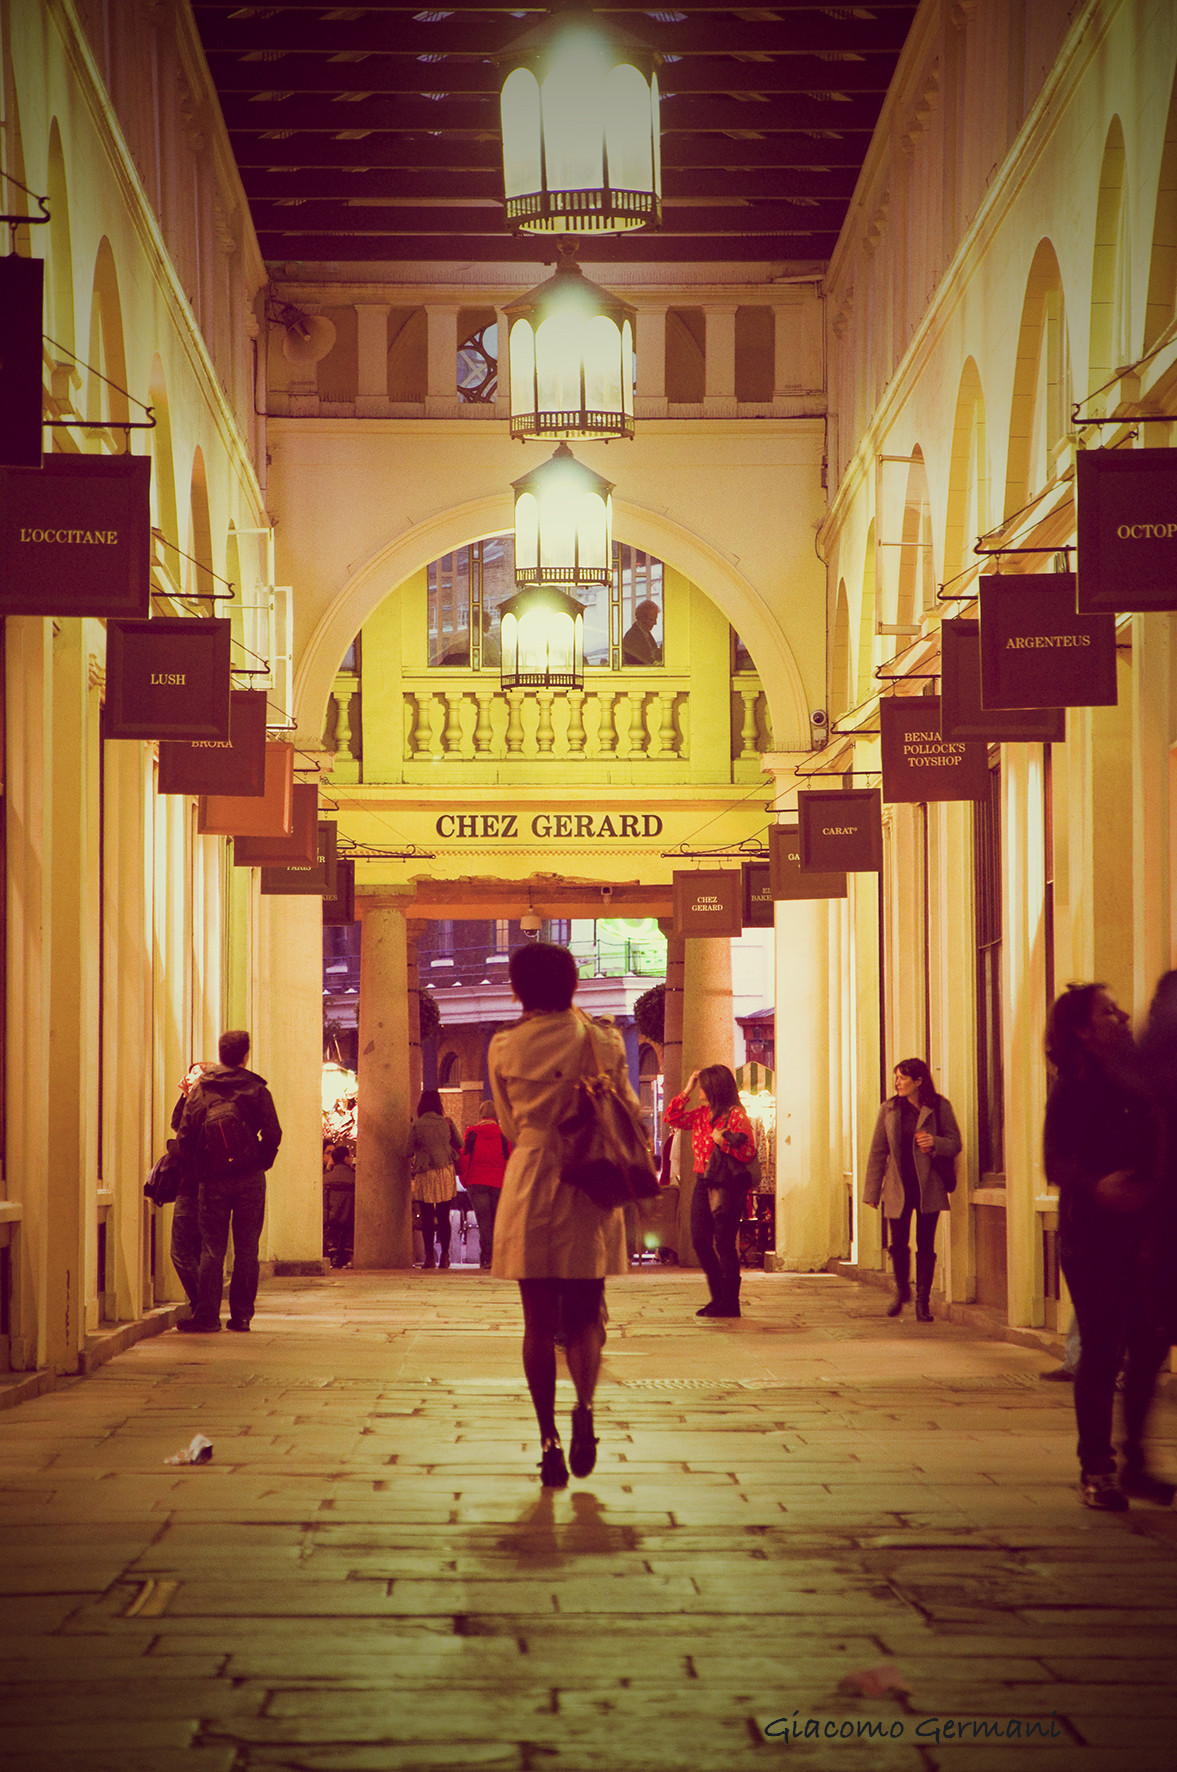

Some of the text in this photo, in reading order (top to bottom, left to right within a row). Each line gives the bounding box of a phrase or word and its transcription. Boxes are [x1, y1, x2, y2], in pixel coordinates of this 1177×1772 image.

[20, 528, 118, 544] L'OCCITANE
[1006, 635, 1091, 649] ARGENTEUS
[150, 673, 186, 685] LUSH
[903, 743, 966, 755] POLLOCK'S
[908, 756, 962, 767] TOYSHOP
[435, 815, 663, 838] CHEZ GERARD
[697, 896, 717, 904] CHEZ
